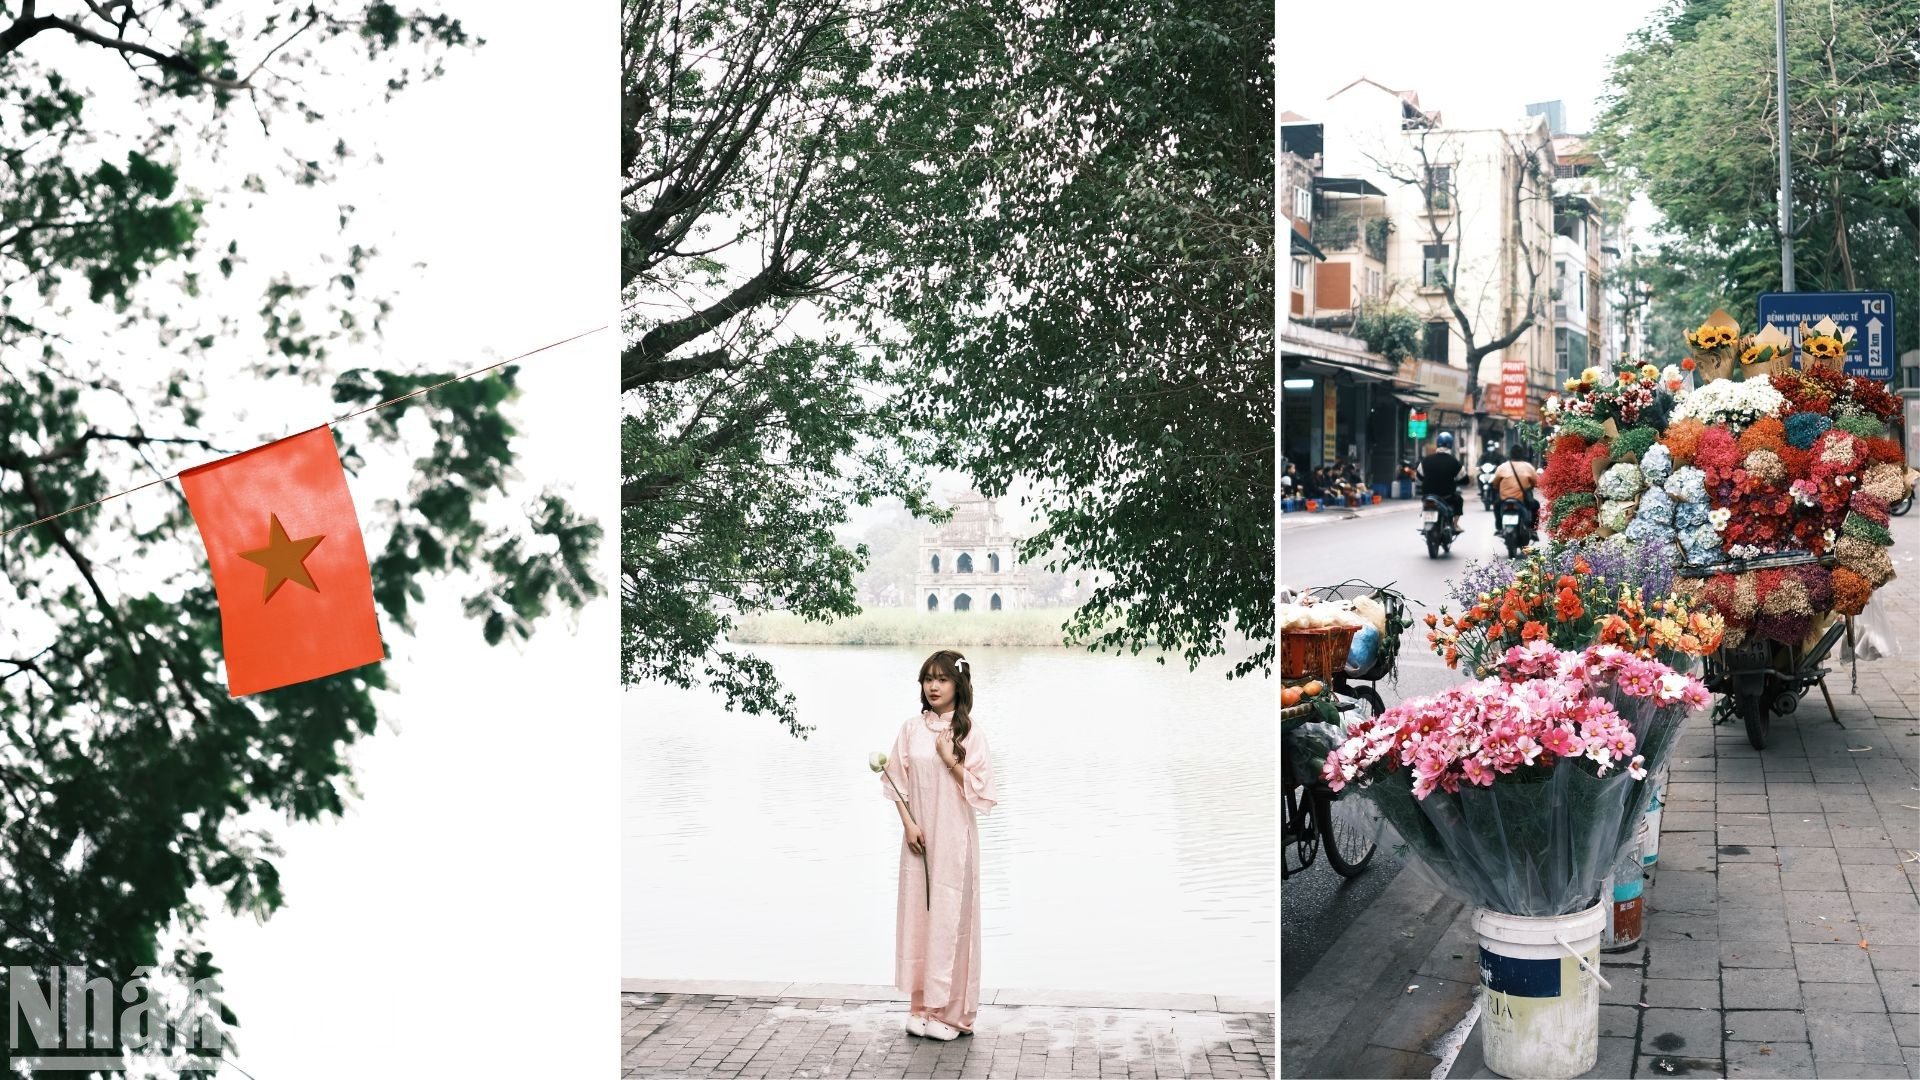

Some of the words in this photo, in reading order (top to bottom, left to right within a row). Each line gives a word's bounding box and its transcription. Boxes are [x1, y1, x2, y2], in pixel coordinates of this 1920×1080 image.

[1862, 299, 1885, 315] TCI
[1502, 362, 1525, 371] PRINT
[1502, 374, 1525, 383] PHOTO
[1504, 385, 1522, 395] COPY
[1504, 398, 1523, 407] SCAN
